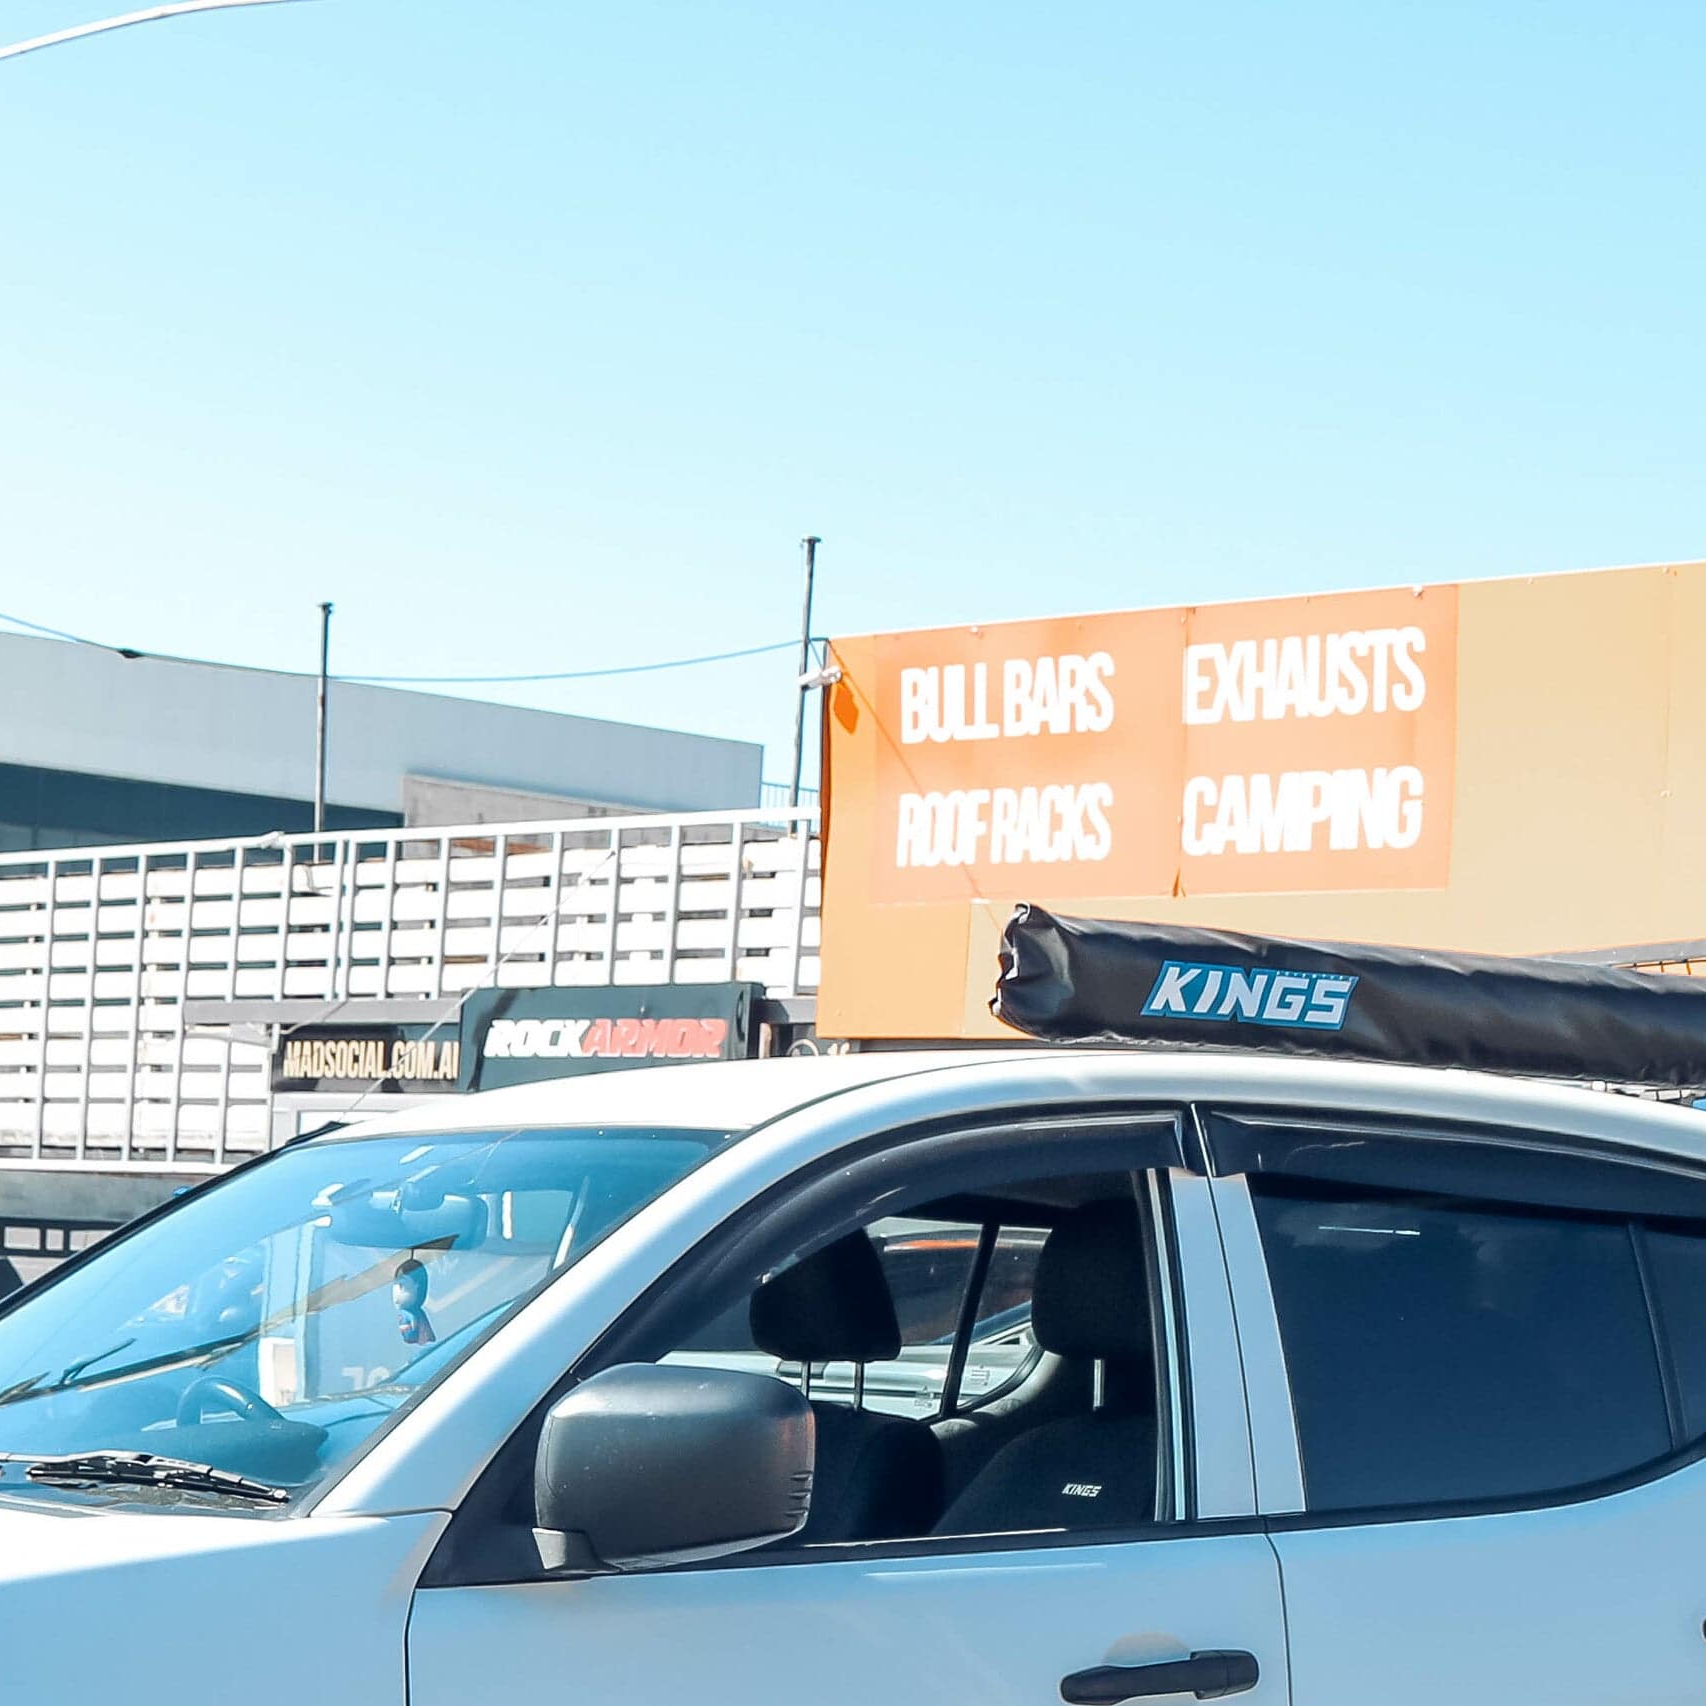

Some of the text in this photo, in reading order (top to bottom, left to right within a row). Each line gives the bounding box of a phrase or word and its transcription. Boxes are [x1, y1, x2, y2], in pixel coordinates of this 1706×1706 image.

[901, 652, 1115, 744] BULL BARS
[1183, 627, 1426, 725] EXHAUSTS
[896, 782, 1113, 867] ROOF RACKS
[1182, 766, 1423, 856] CAMPING
[1149, 966, 1352, 1025] KINGS
[1062, 1483, 1102, 1497] KINGS
